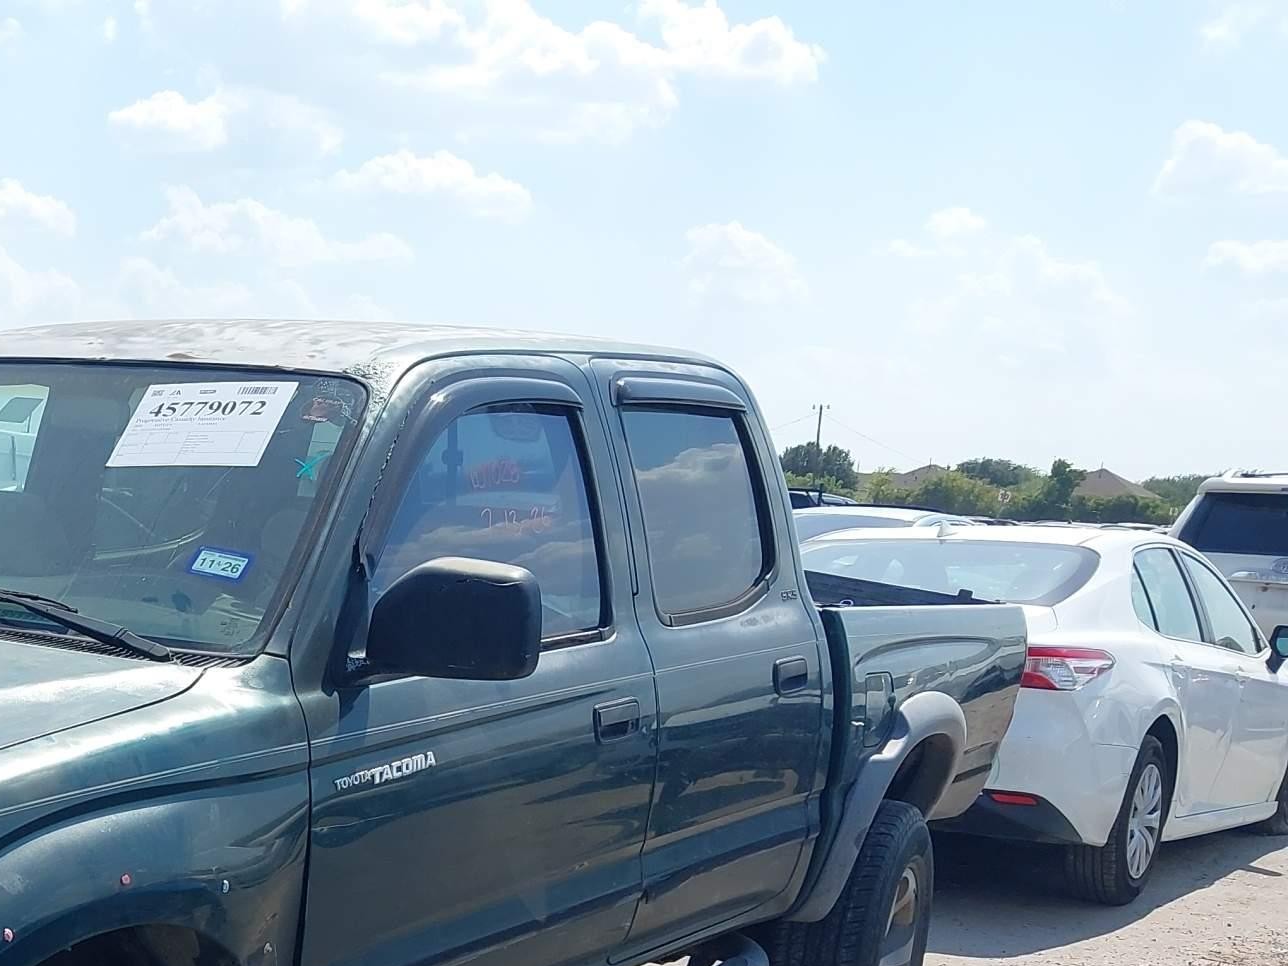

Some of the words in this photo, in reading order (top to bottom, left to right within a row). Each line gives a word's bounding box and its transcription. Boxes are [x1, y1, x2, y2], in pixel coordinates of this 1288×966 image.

[149, 400, 267, 417] 45779072
[334, 769, 372, 791] TOYOTA
[372, 751, 436, 785] TACOMA
